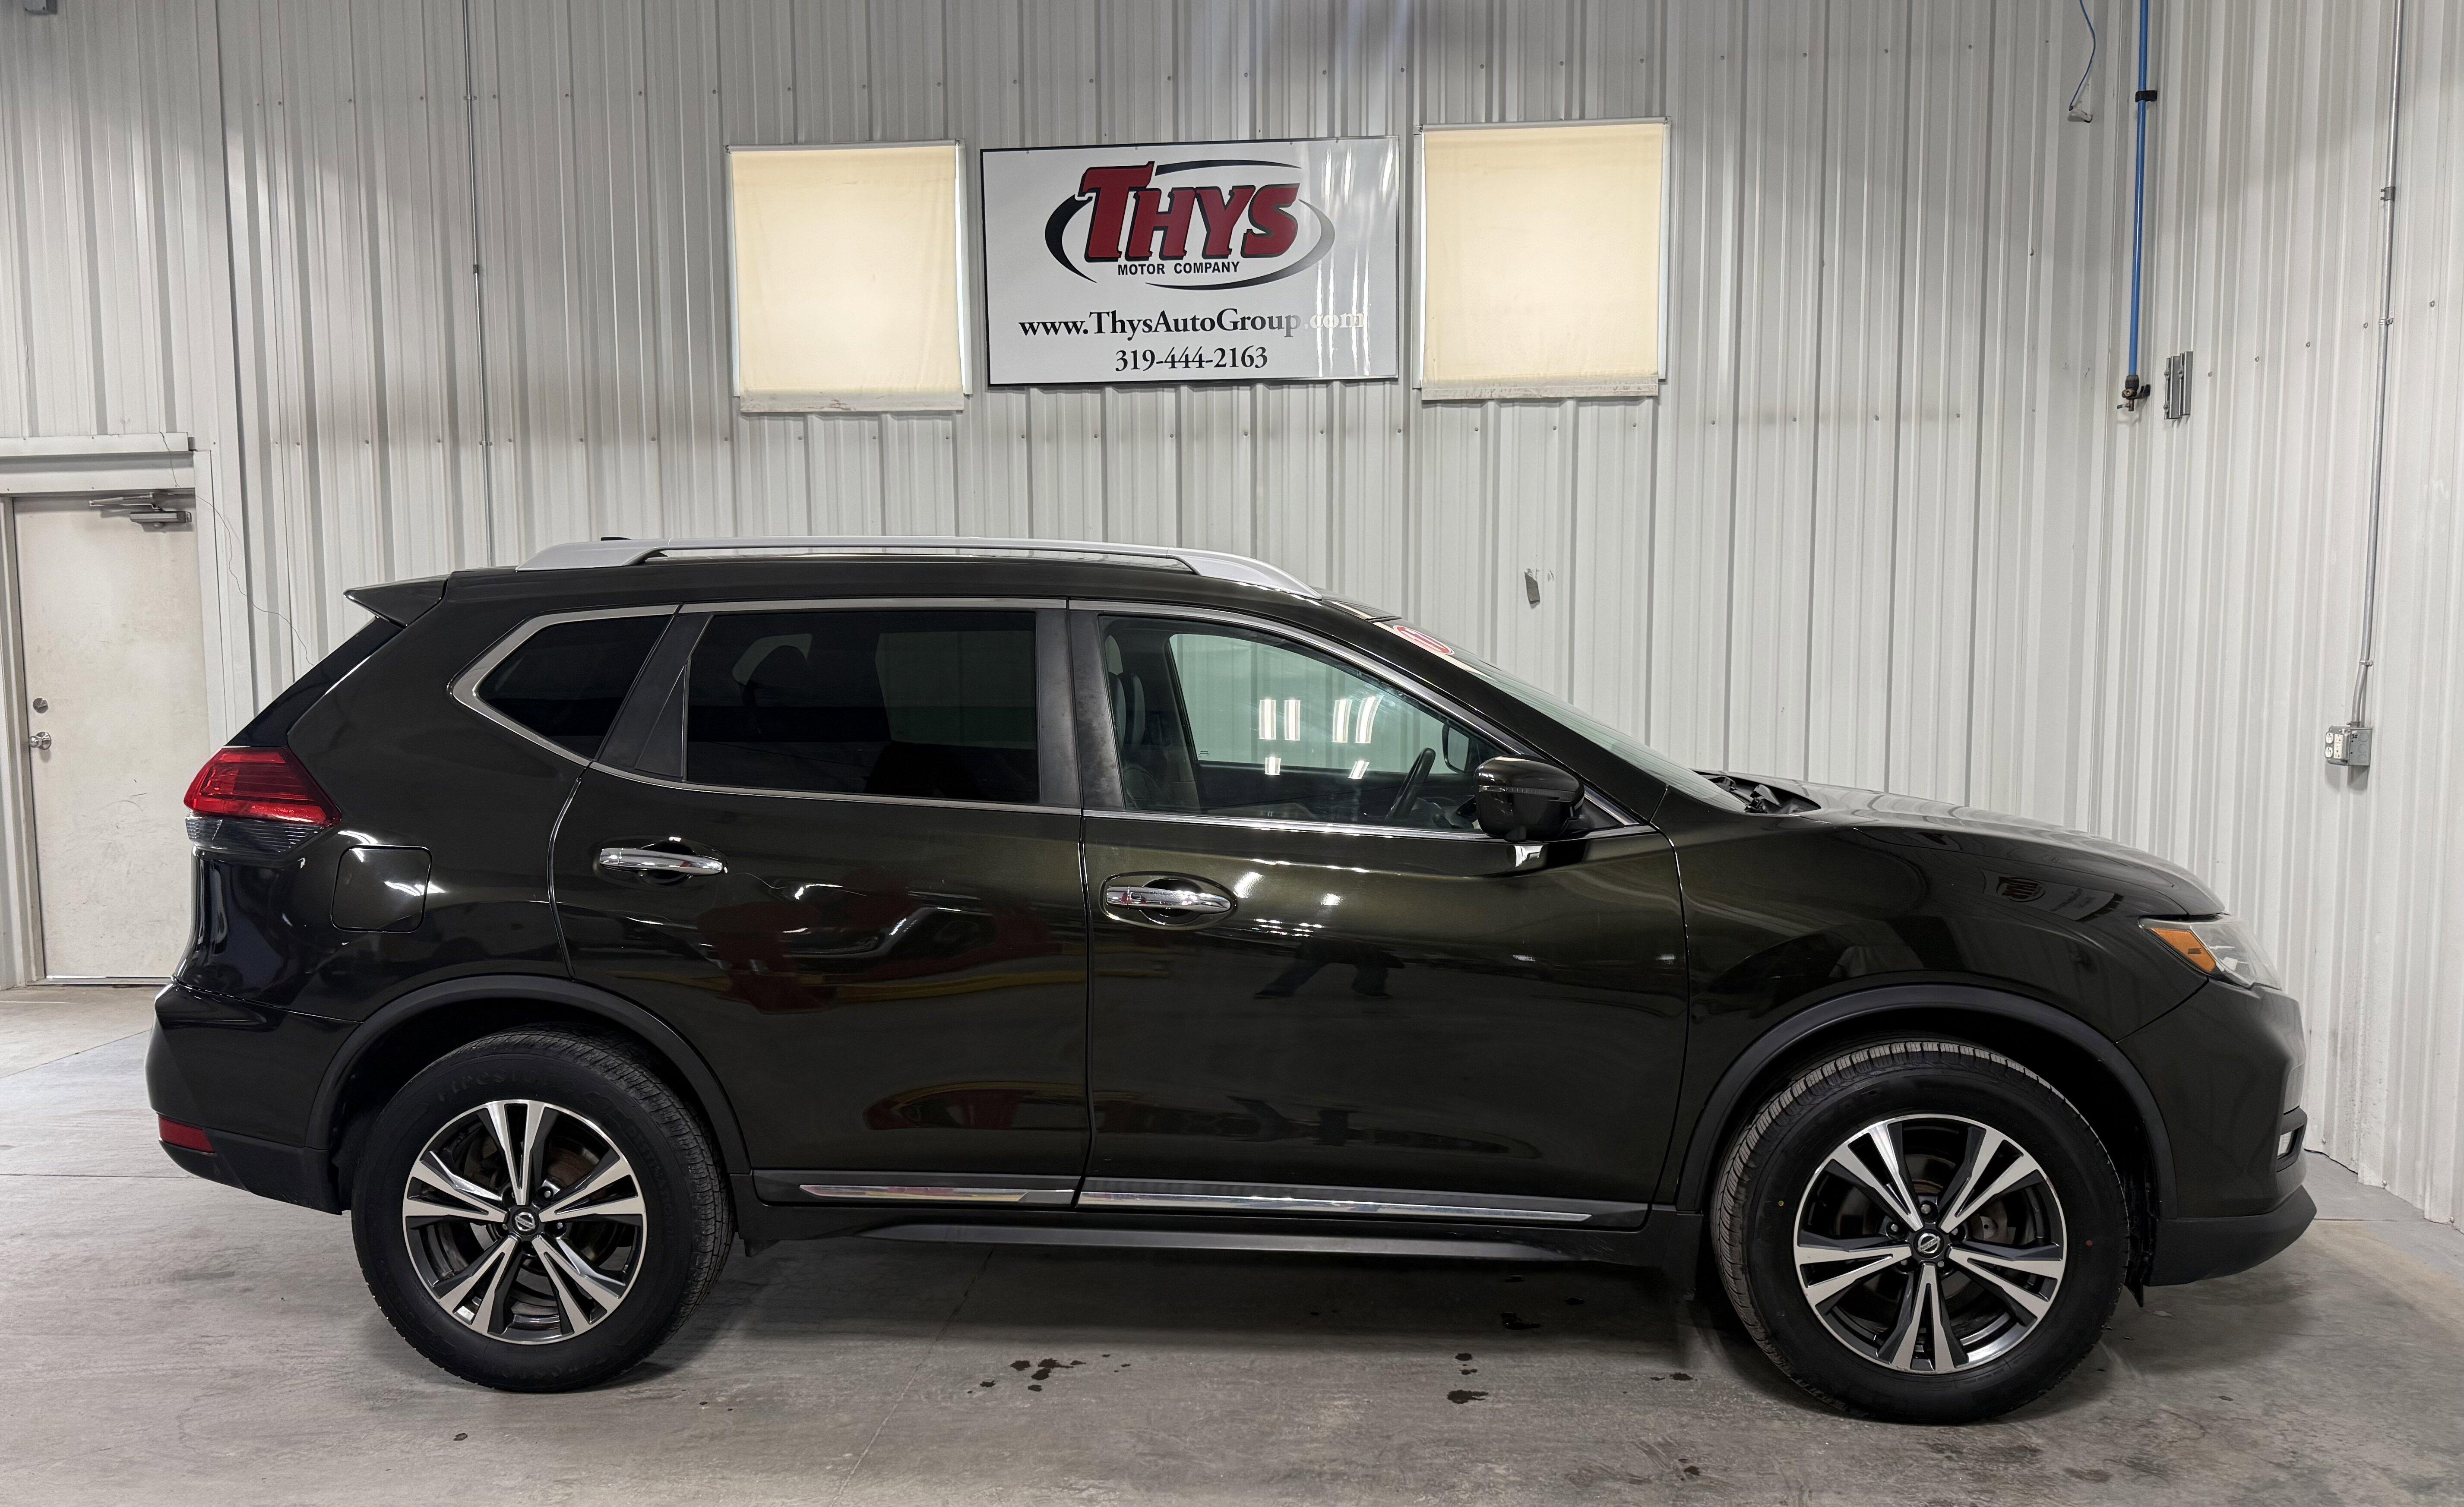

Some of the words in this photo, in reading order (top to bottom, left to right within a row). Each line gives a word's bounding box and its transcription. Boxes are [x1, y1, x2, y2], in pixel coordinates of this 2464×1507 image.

[1078, 160, 1300, 263] THYS
[1117, 263, 1165, 275] MOTOR
[1173, 261, 1240, 274] COMPANY
[1018, 308, 1365, 341] www.ThysAutoGroup.com
[1115, 345, 1268, 372] 319-444-2163
